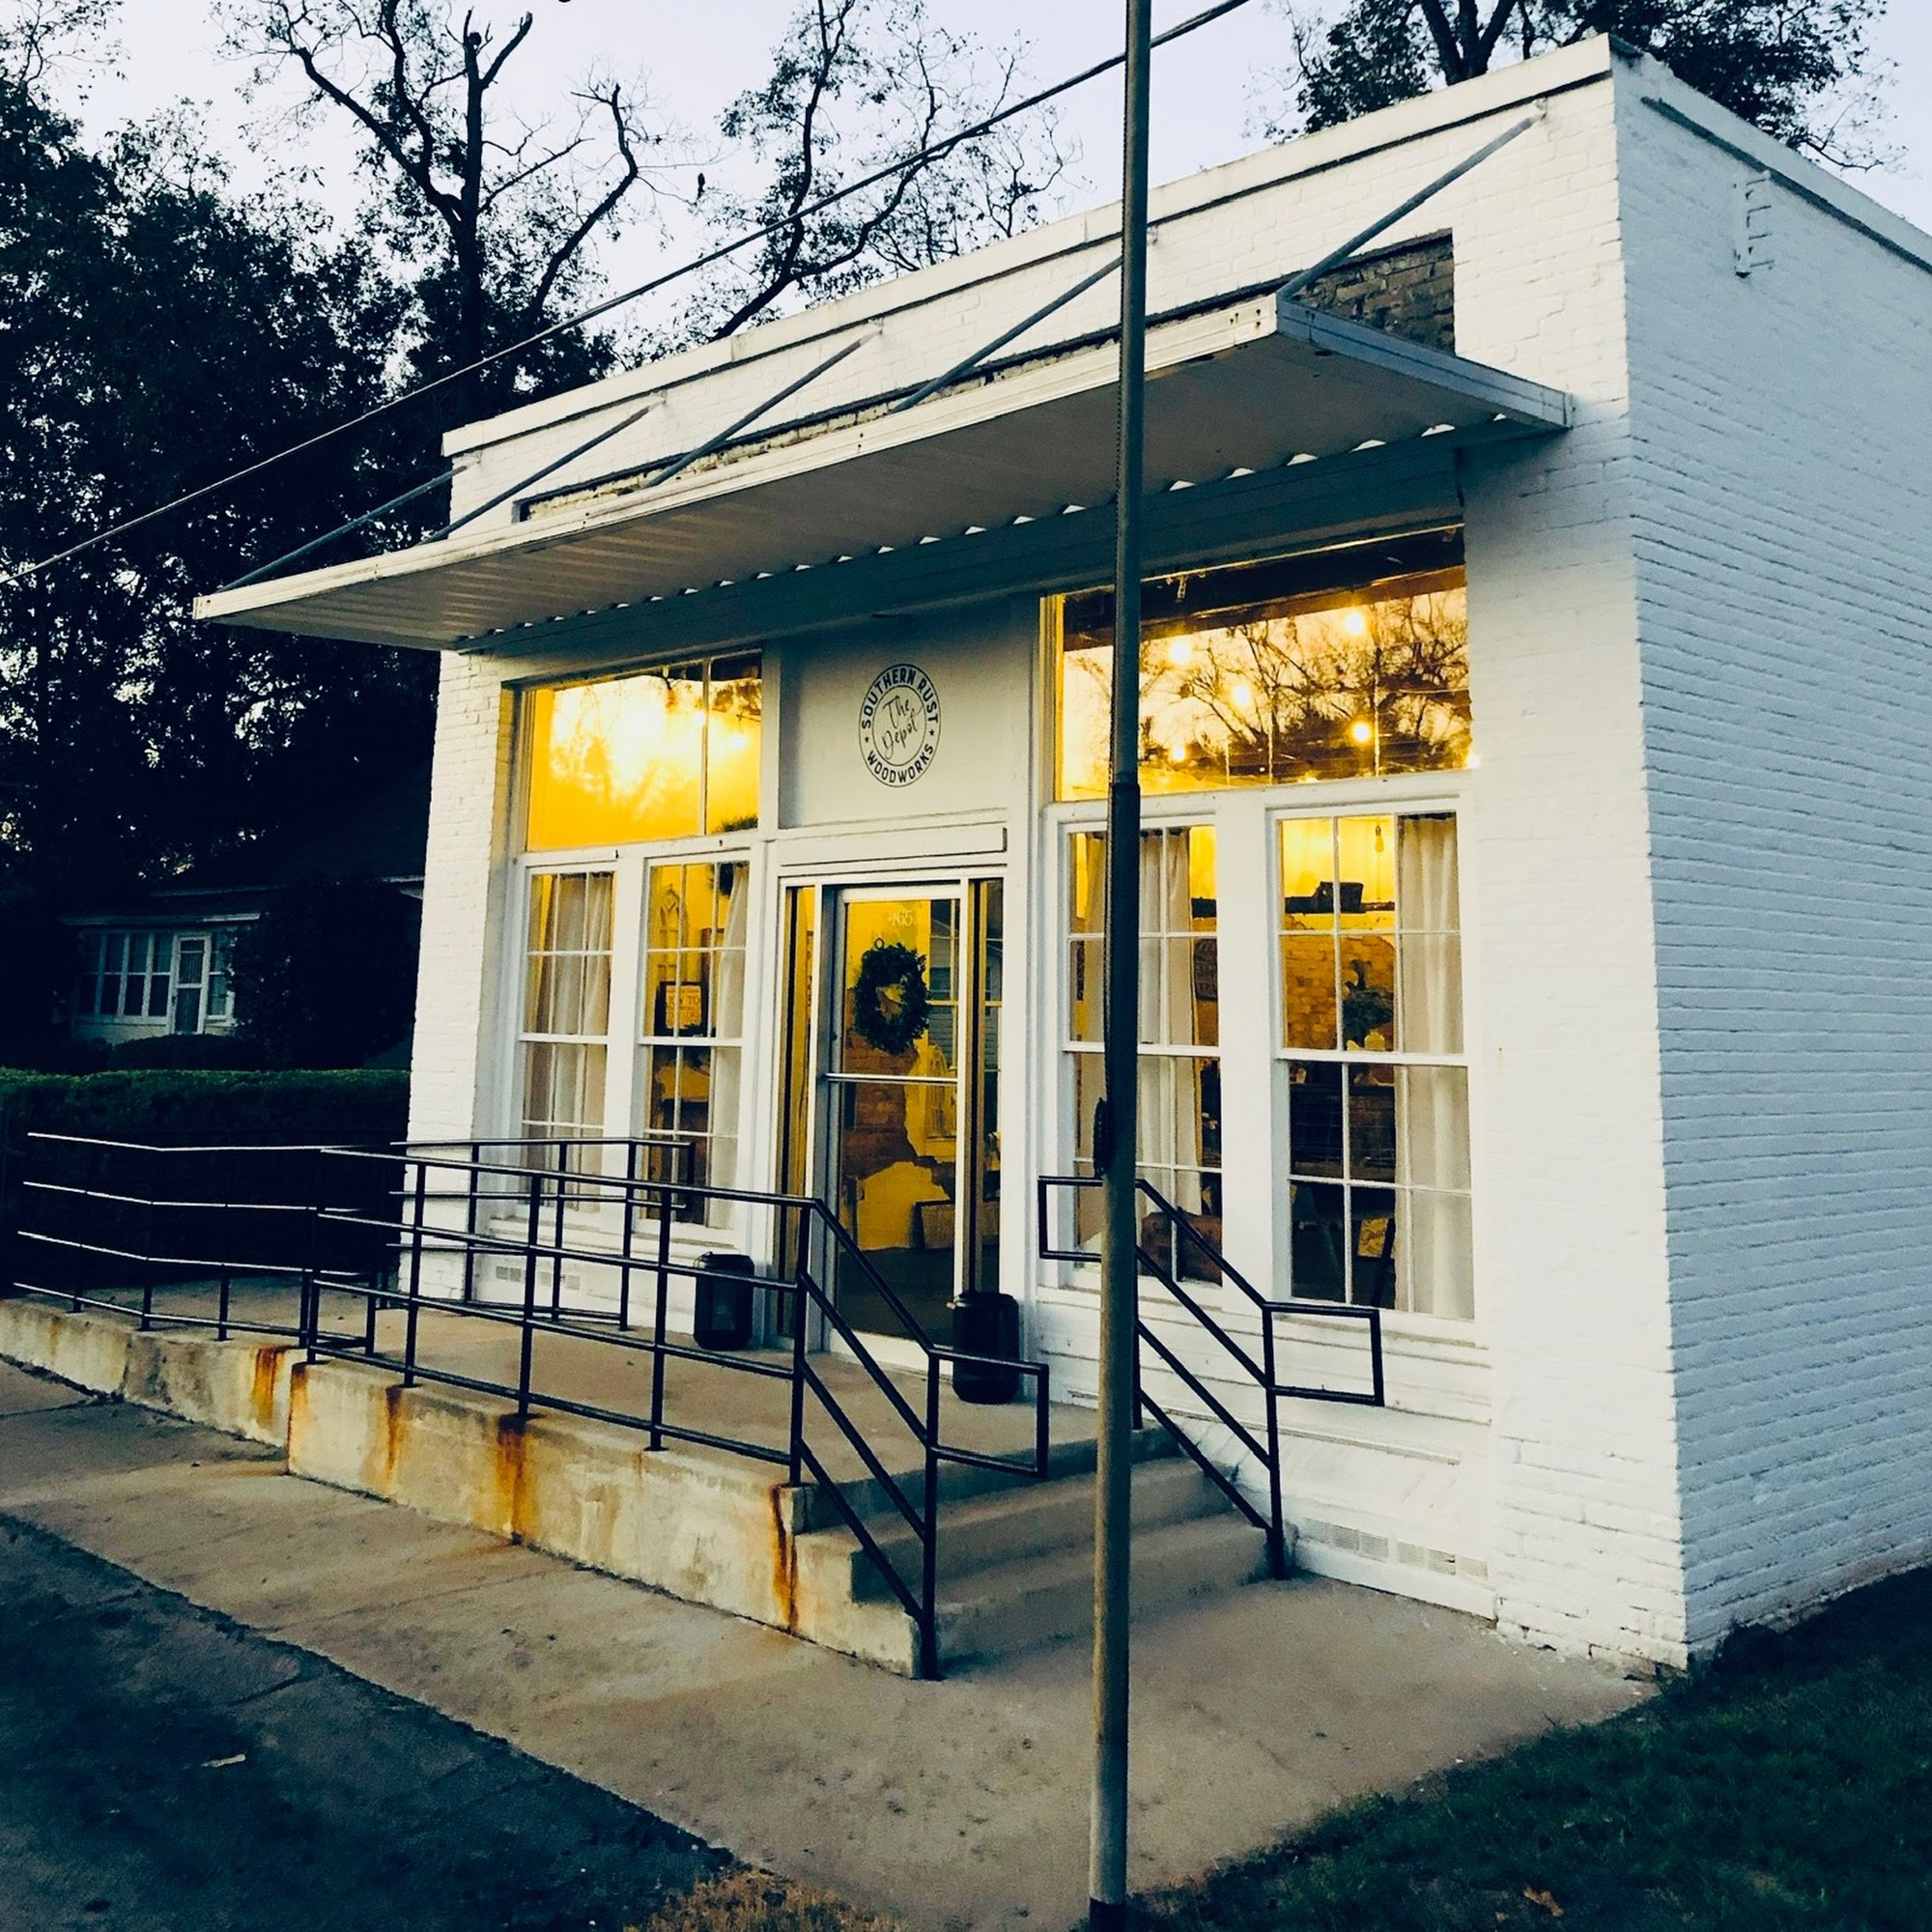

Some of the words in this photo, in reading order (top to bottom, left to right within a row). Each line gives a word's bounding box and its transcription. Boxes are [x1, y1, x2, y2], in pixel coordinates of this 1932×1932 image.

[862, 668, 917, 729] SOUTHERN
[917, 677, 938, 724] RUST
[882, 695, 911, 729] The
[881, 706, 923, 760] Depot
[867, 743, 934, 783] WOODWORKS
